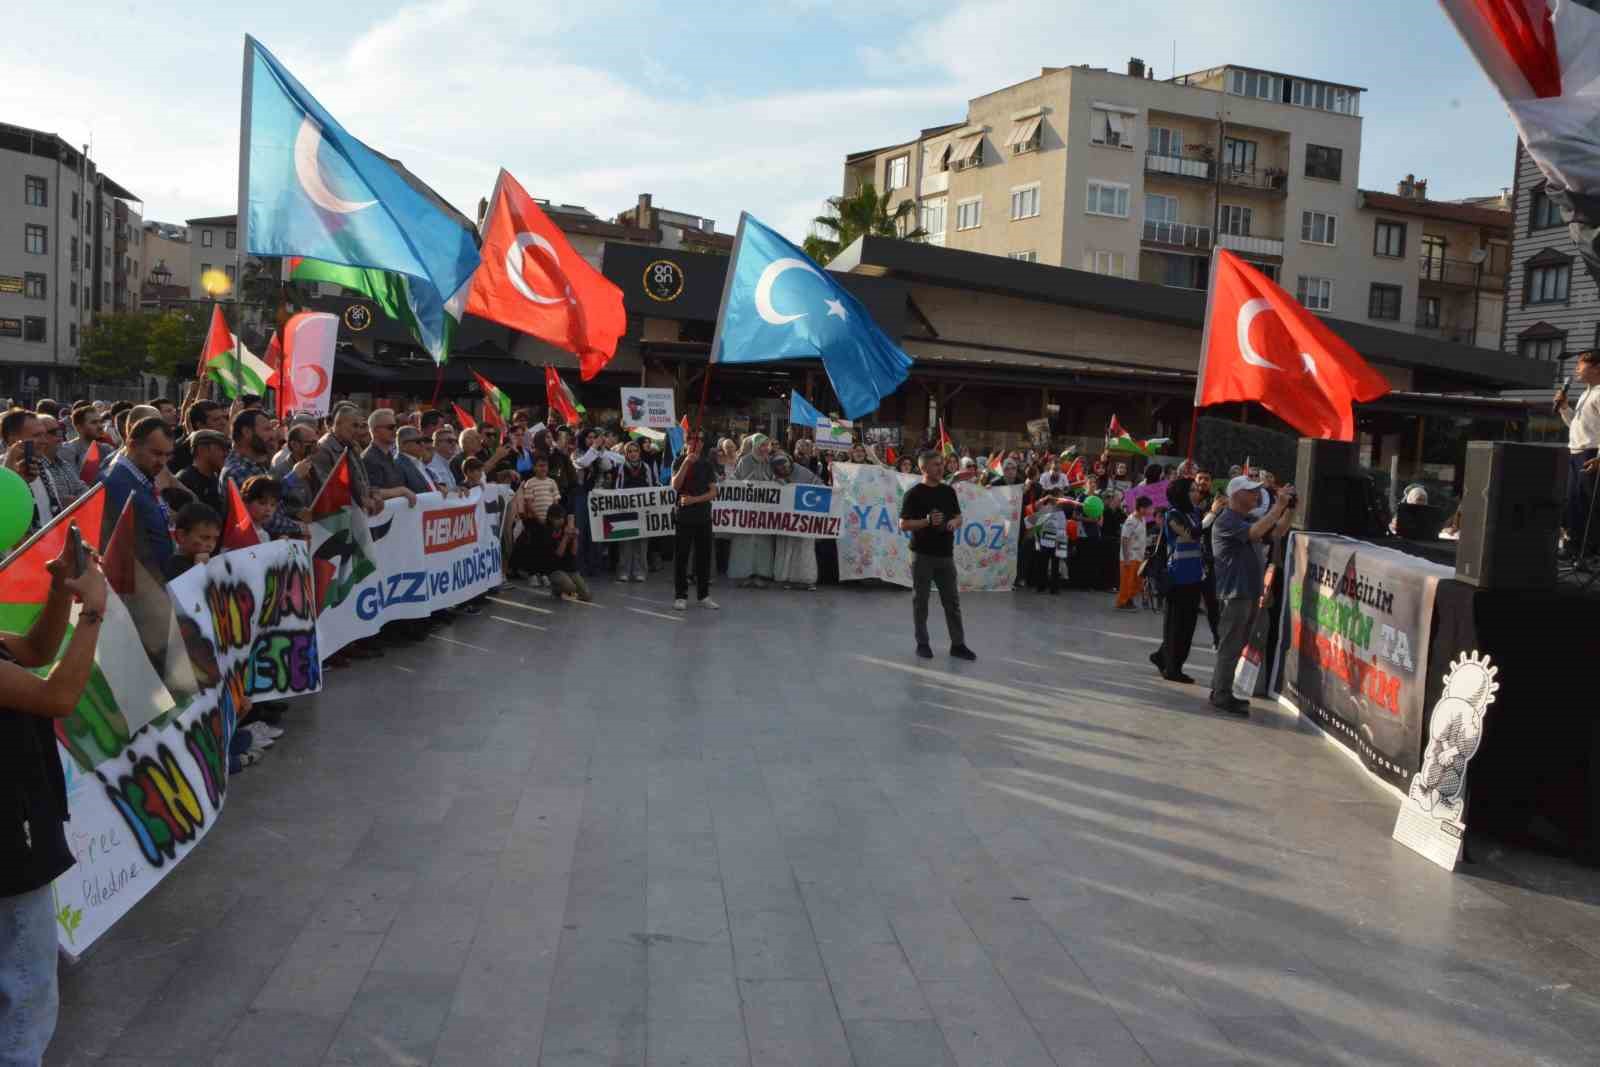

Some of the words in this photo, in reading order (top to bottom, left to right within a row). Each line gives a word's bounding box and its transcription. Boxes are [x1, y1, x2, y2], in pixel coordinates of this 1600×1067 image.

[590, 491, 656, 517] ŞEHADETLE
[711, 509, 841, 536] USTURAMAZSINIZ!
[430, 571, 450, 595] ve
[1381, 622, 1415, 673] TA
